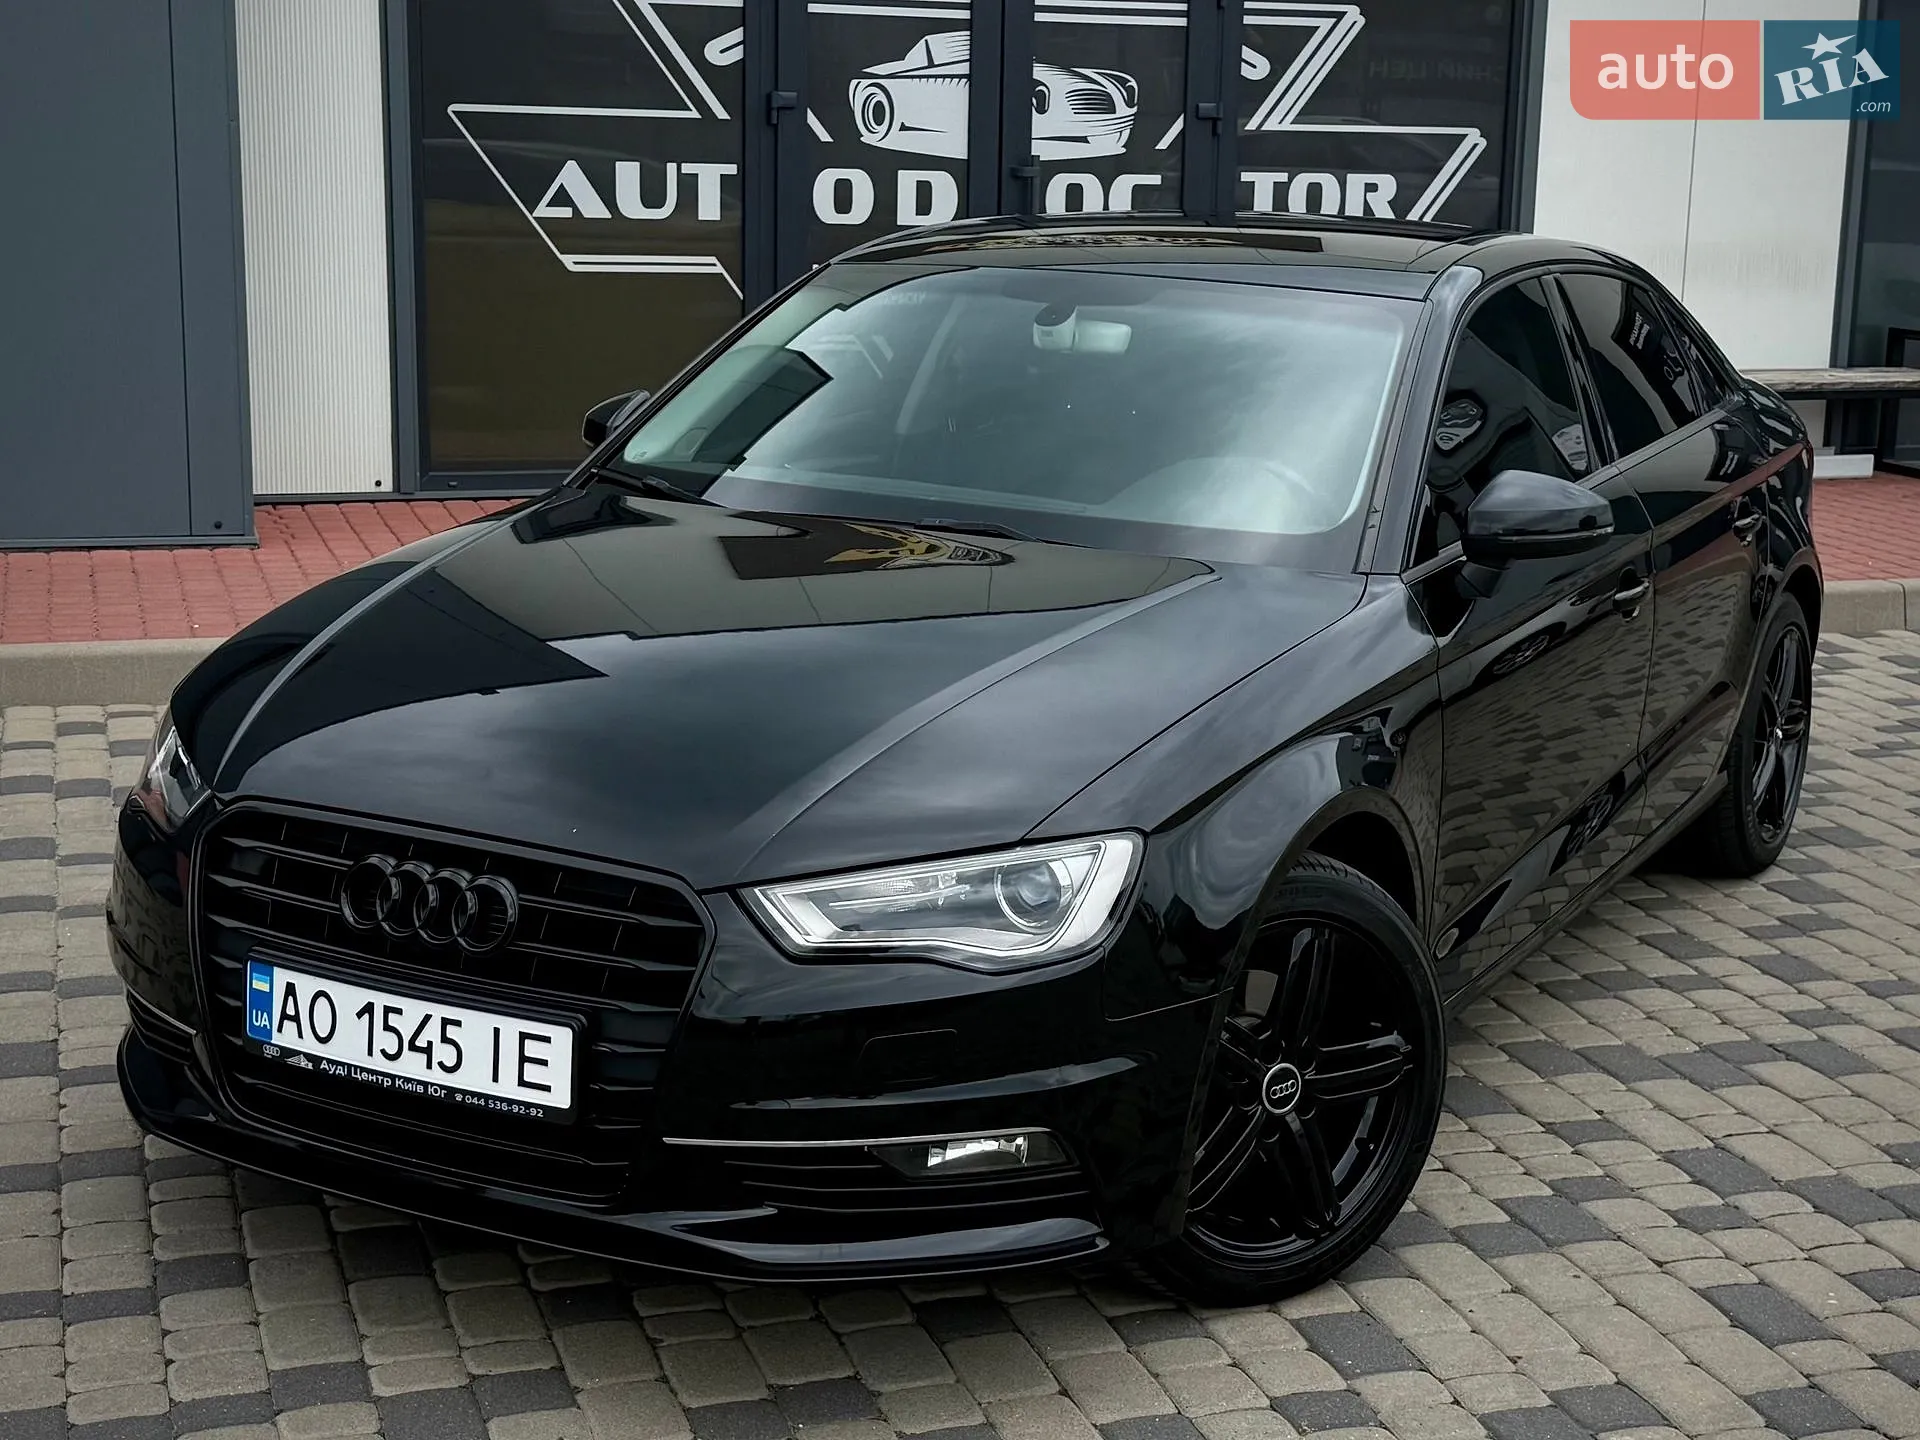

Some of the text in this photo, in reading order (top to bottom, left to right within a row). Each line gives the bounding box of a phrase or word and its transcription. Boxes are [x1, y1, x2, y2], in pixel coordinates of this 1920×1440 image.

[252, 1009, 270, 1030] UA
[277, 980, 552, 1093] AO 1545 IE
[320, 1059, 448, 1098] Ауді Центр Київ Юг
[464, 1095, 486, 1107] 044
